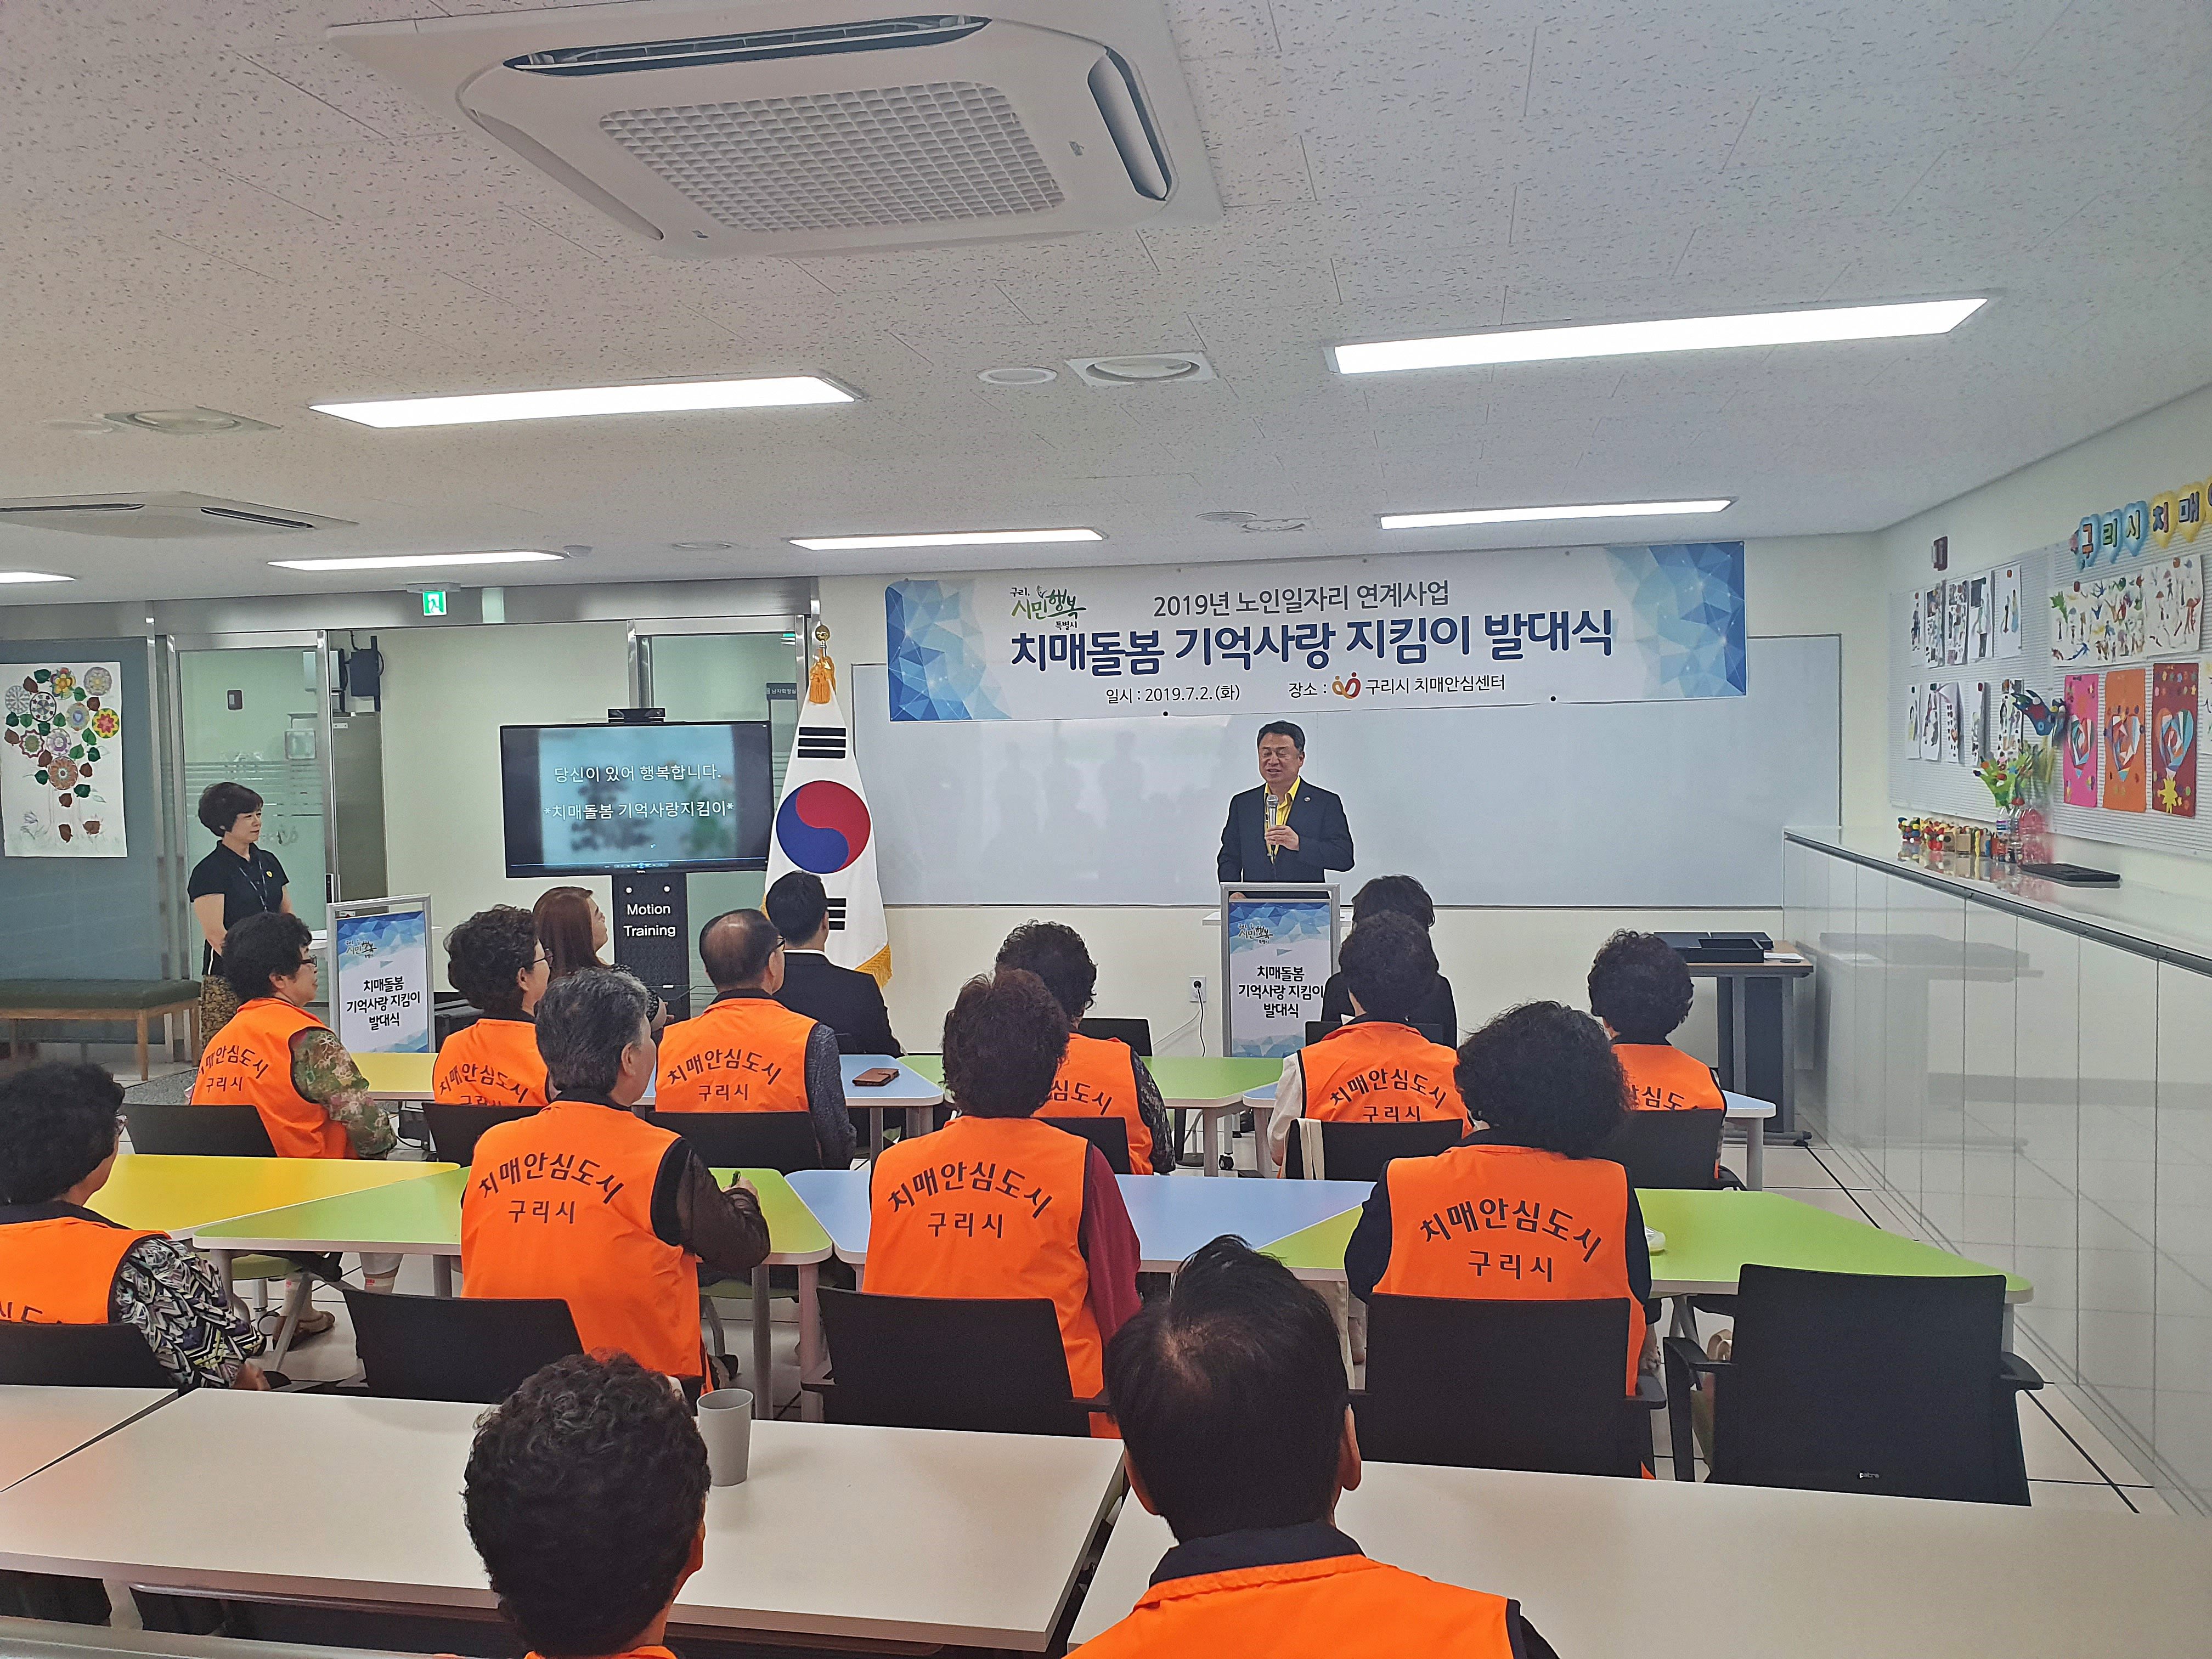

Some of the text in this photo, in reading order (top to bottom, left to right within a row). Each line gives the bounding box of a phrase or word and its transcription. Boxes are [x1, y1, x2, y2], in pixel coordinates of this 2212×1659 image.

[2082, 510, 2141, 558] 구리시
[1011, 589, 1087, 620] 시민행복
[1154, 580, 1449, 617] 2019년 노인일자리 연계사업
[1055, 620, 1077, 630] 특별시
[1011, 609, 1612, 676] 치매돌봄 기억사랑 지킴이 발대식
[1106, 689, 1132, 704] 일시
[1145, 684, 1240, 703] 2019.7.2.(화)
[1288, 681, 1318, 698] 장소
[1365, 677, 1410, 696] 구리시
[1414, 674, 1505, 695] 치매안심센터
[554, 763, 721, 783] 당신이 있어 행복합니다.
[627, 904, 670, 915] Motion
[623, 924, 676, 937] Training
[363, 976, 404, 992] 치매돌봄
[1257, 966, 1305, 981] 치매돌봄
[347, 991, 420, 1014] 기억사랑 지킴이
[1238, 984, 1324, 1001] 기억사랑 지킴이
[369, 1012, 400, 1031] 발대식
[1263, 1003, 1299, 1019] 발대식
[199, 1045, 269, 1079] 매안심도시
[667, 1048, 782, 1085] 치매안심도시
[206, 1076, 243, 1093] 구리시
[698, 1083, 748, 1102] 구리시
[1330, 1068, 1446, 1109] 치매안심도시
[1363, 1105, 1420, 1121] 구리시
[479, 1152, 624, 1204] 치매안심도시
[888, 1161, 1053, 1219] 치매안심도시
[508, 1200, 575, 1224] 구리시
[928, 1212, 1003, 1238] 구리시
[1420, 1198, 1601, 1263] 치매안심도시
[1468, 1250, 1553, 1282] 구리시
